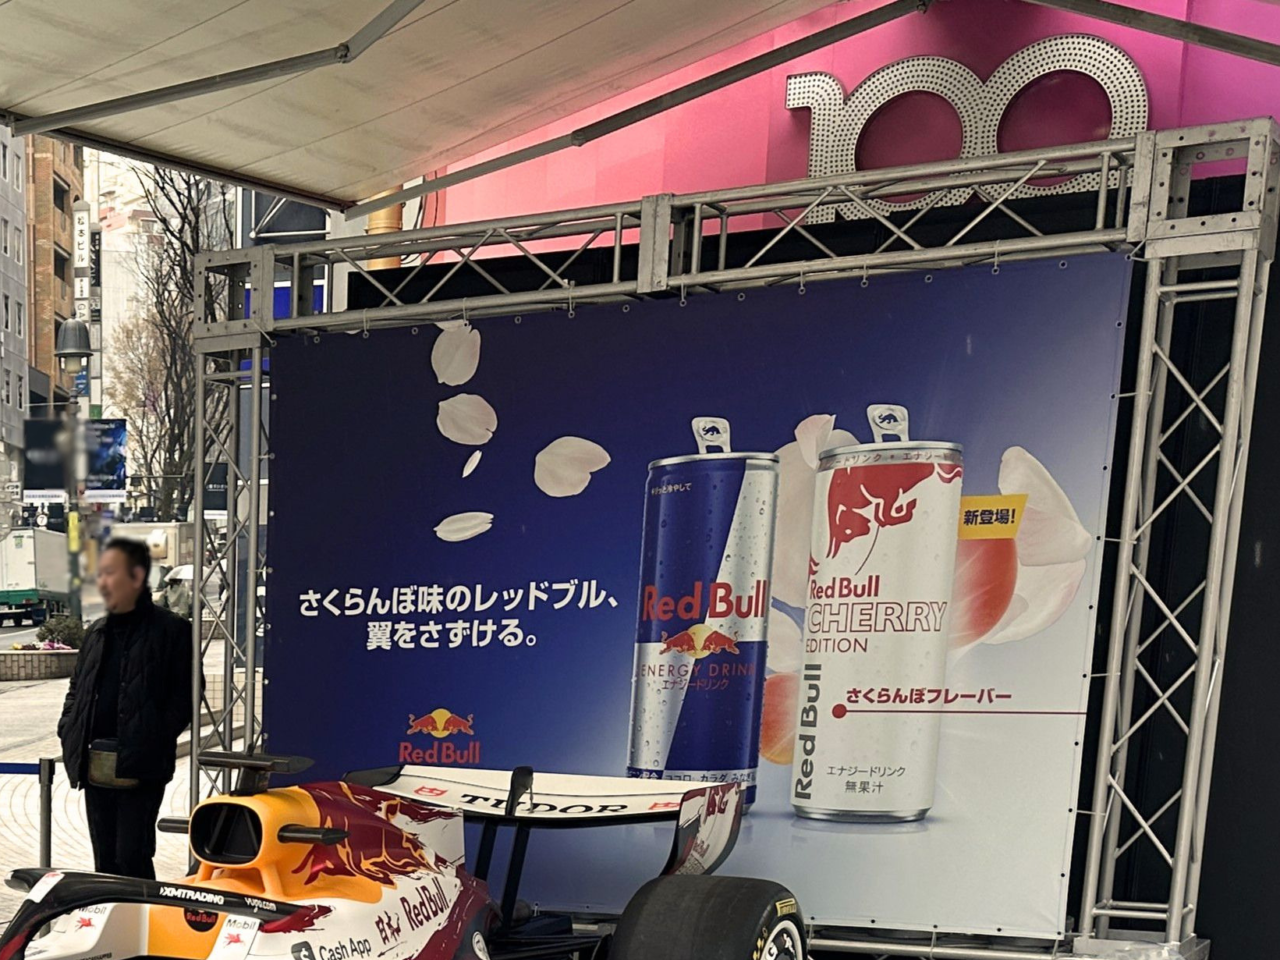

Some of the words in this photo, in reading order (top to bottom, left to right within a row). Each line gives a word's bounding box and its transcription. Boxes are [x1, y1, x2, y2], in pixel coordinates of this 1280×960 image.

[298, 579, 618, 617] さくらんぼ味のレッドブル、
[810, 576, 836, 600] Red
[838, 574, 880, 598] Bull
[642, 580, 702, 621] Red
[708, 578, 767, 620] Bull
[806, 600, 948, 634] CHERRY
[366, 618, 537, 650] 翼をさずける。
[806, 636, 869, 653] EDITION
[641, 663, 701, 678] ENERGY
[662, 678, 729, 691] エナジードリンク
[800, 663, 822, 728] Bull
[846, 687, 1012, 704] さくらんぼフレーバー
[398, 742, 439, 764] Red
[441, 742, 481, 764] Bull
[794, 734, 817, 800] Red
[826, 765, 906, 778] エナジードリンク
[844, 780, 884, 794] 無果汁
[400, 886, 429, 931] Red
[420, 876, 450, 917] Bull
[226, 919, 256, 930] Mobil
[348, 937, 372, 960] App
